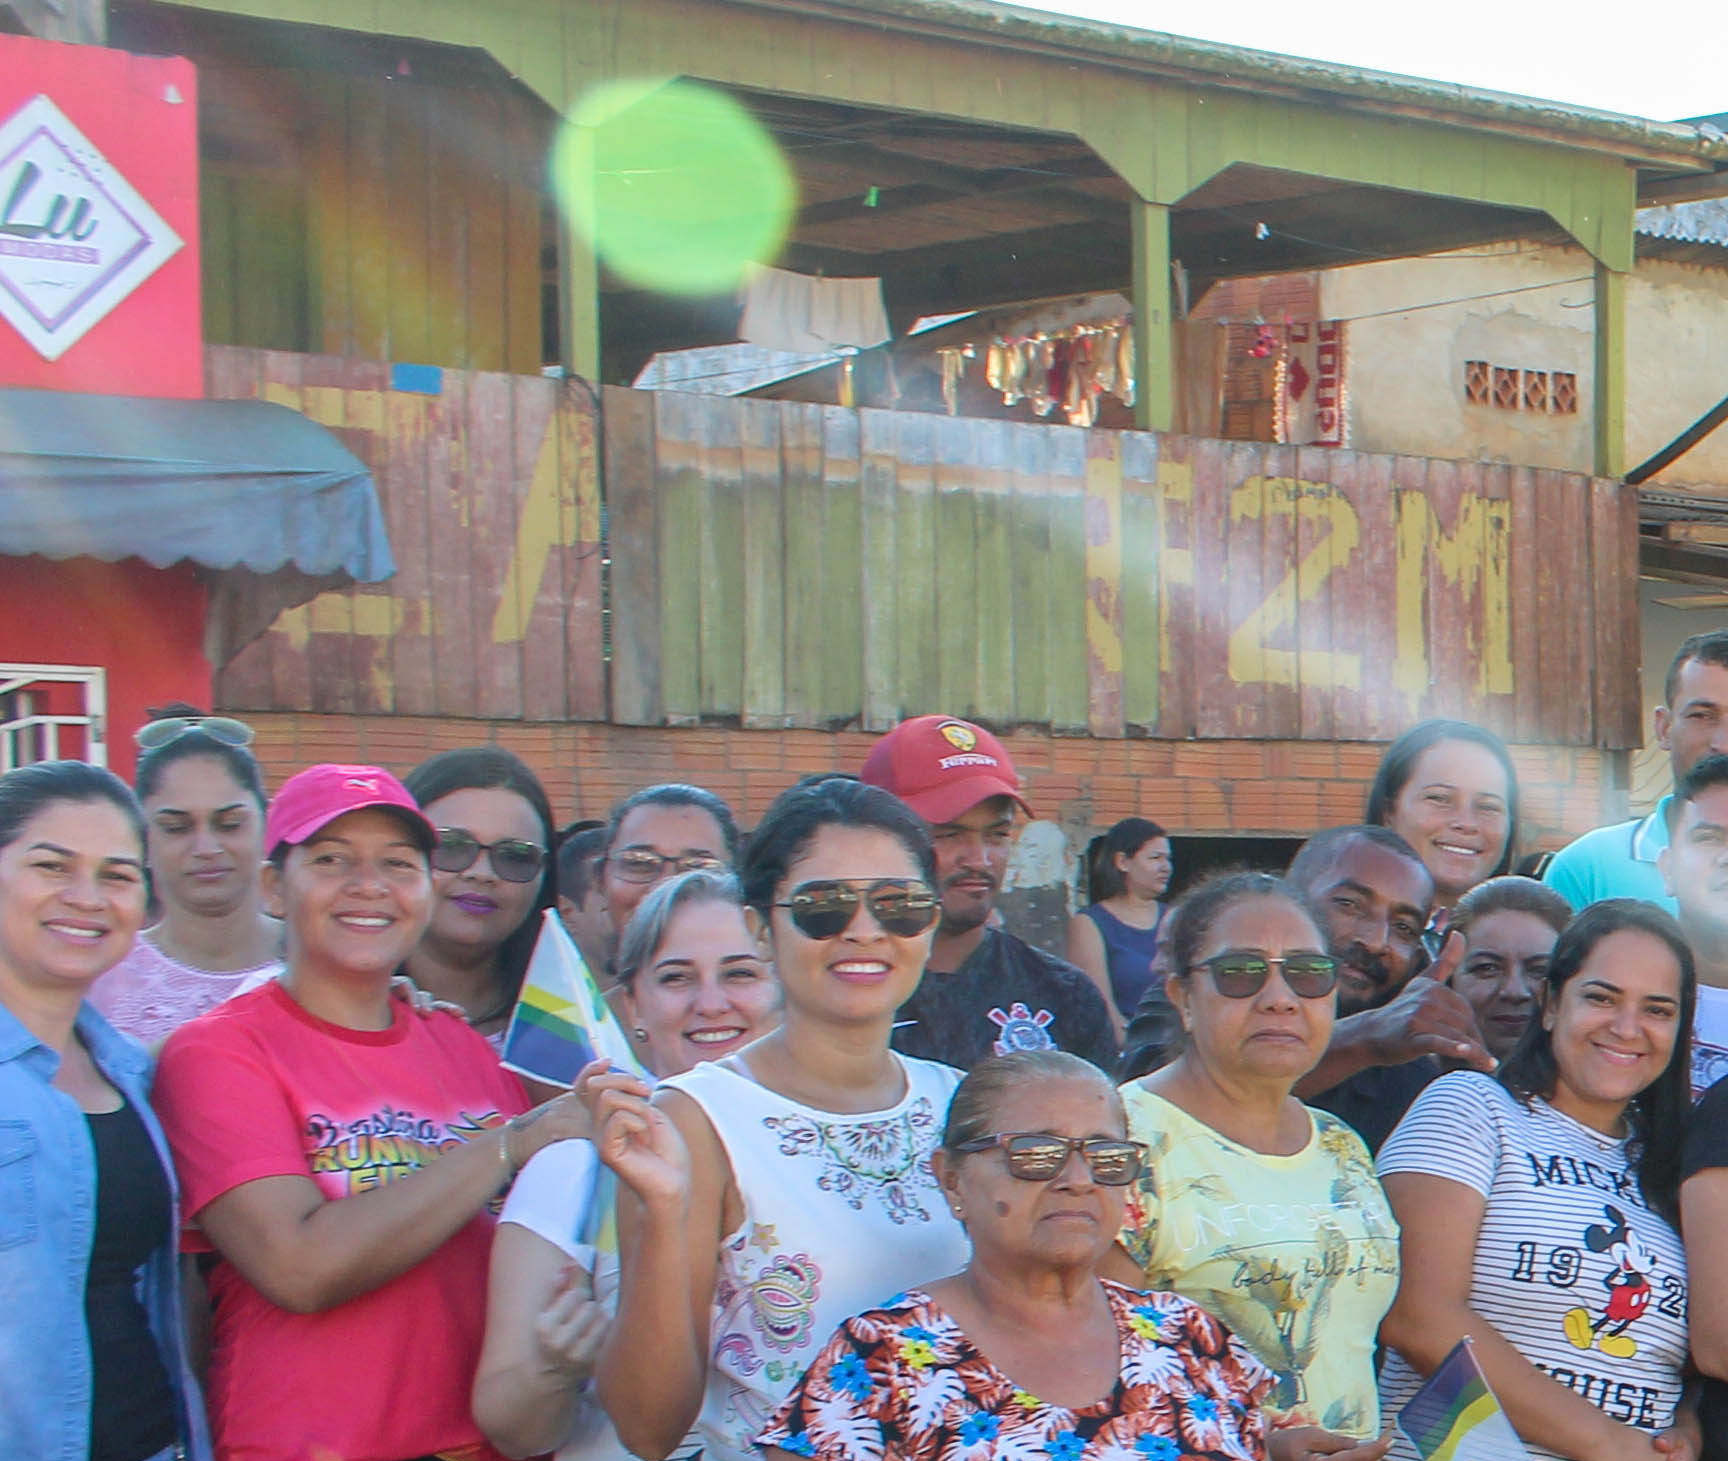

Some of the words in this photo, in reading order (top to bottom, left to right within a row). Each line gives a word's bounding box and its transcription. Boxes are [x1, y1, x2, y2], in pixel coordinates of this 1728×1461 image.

[1527, 1152, 1642, 1207] MICK
[1512, 1240, 1582, 1289] 19
[1658, 1275, 1687, 1319] 2
[1535, 1362, 1659, 1430] OUSE
